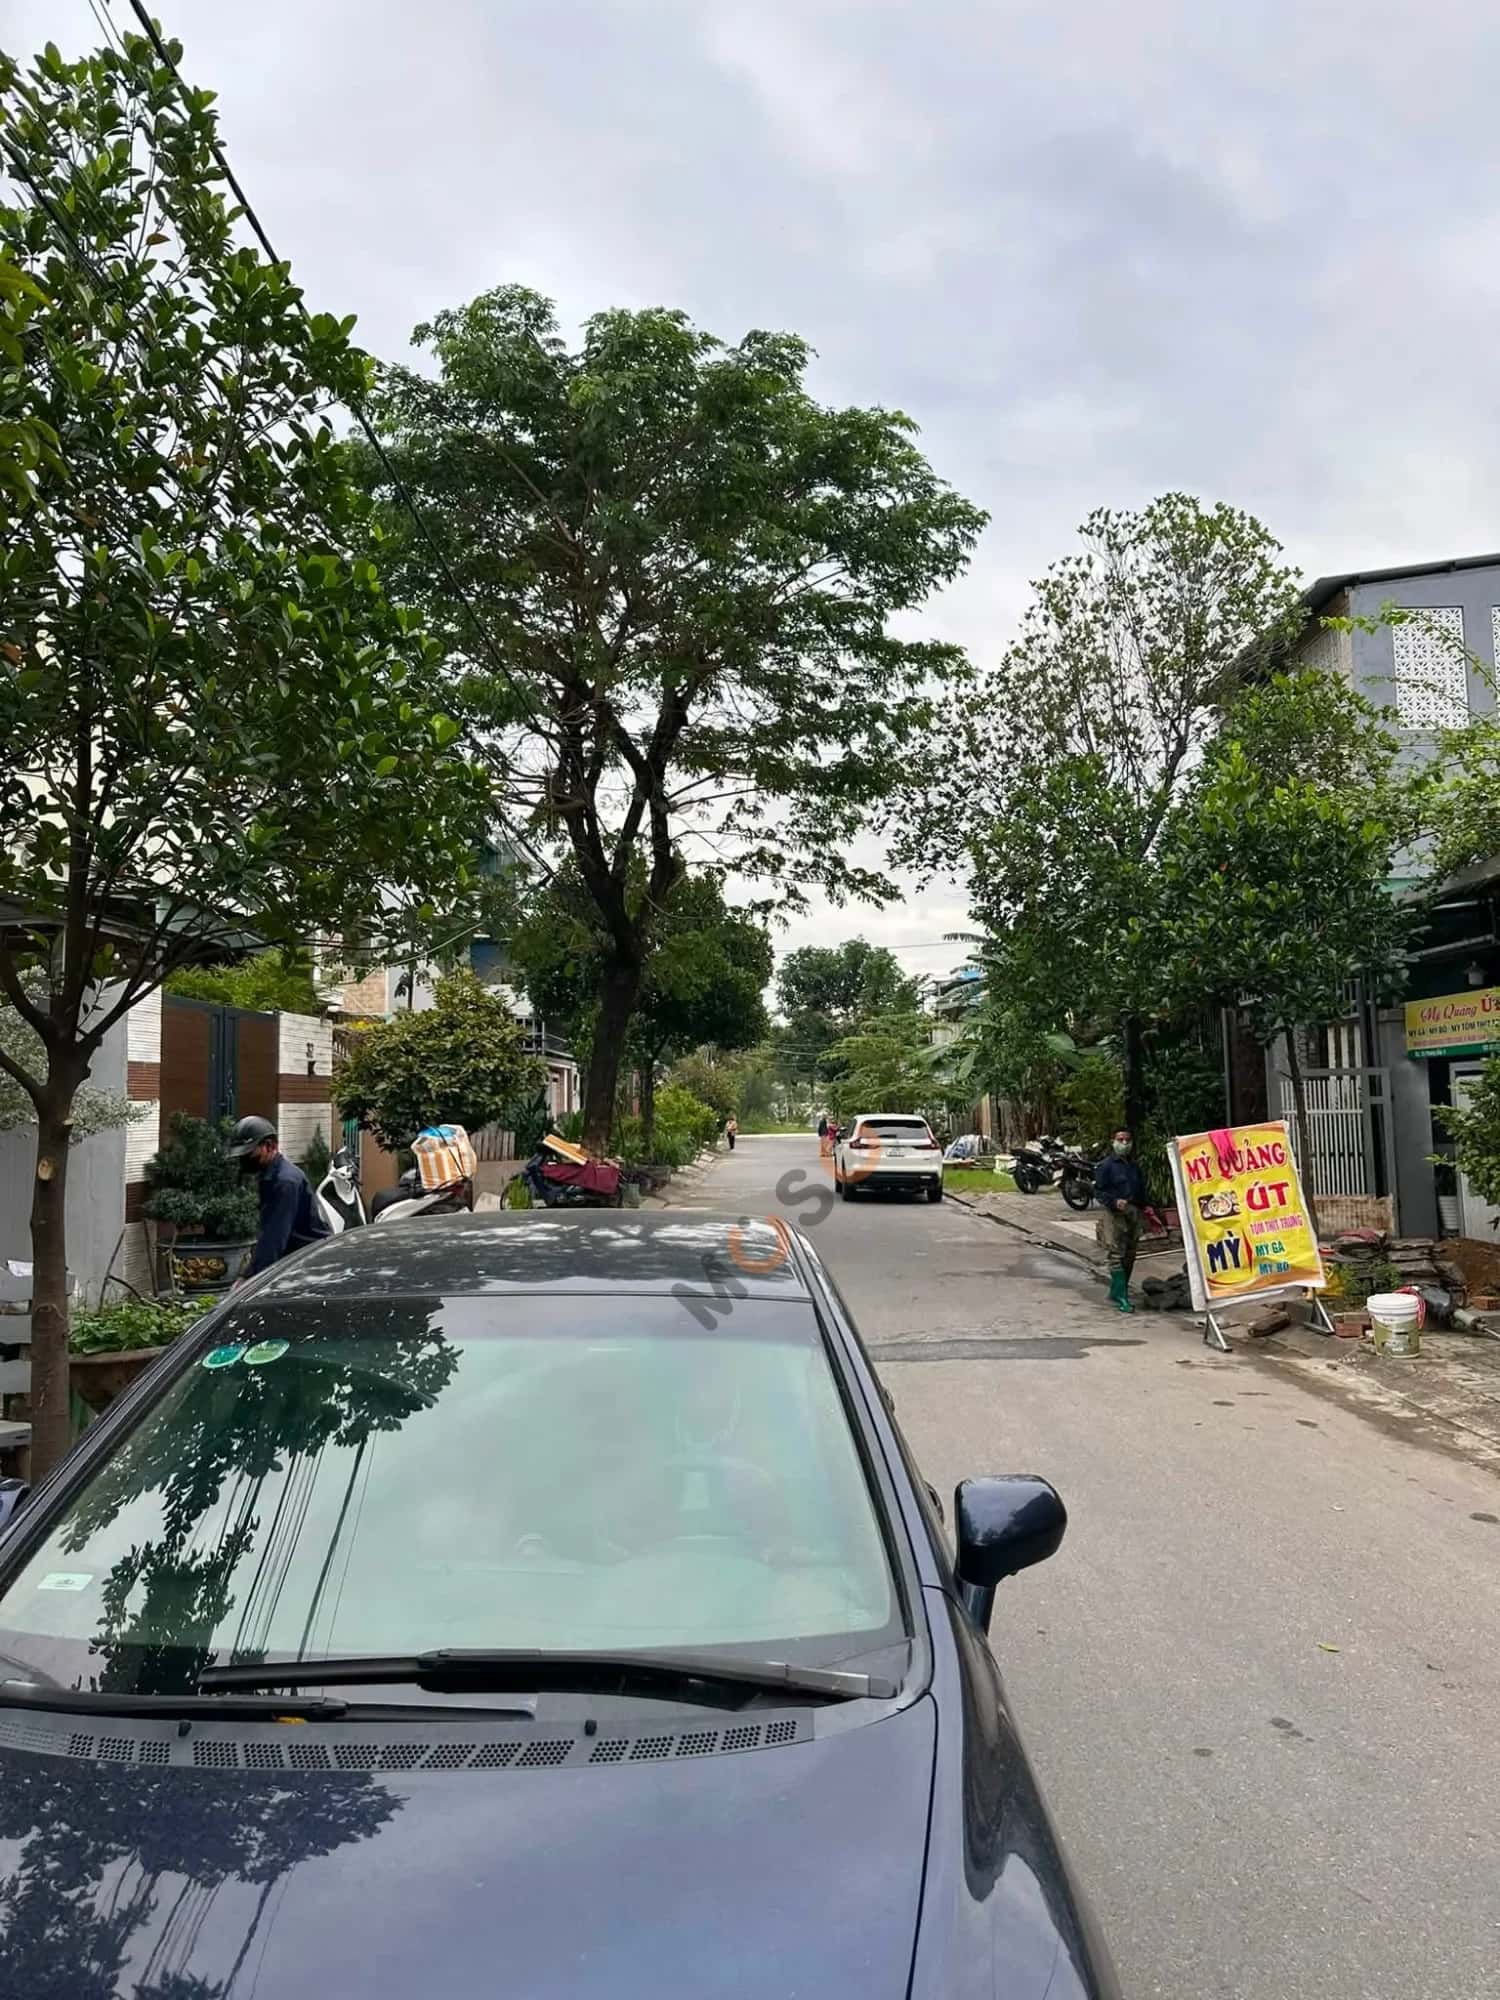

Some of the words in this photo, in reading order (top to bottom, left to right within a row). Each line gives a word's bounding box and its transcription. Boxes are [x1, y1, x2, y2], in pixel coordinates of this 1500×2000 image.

[1186, 1150, 1212, 1182] MỲ
[1217, 1138, 1285, 1180] QUẢNG
[1246, 1181, 1290, 1211] ÚT
[1206, 1231, 1241, 1273] MỲ
